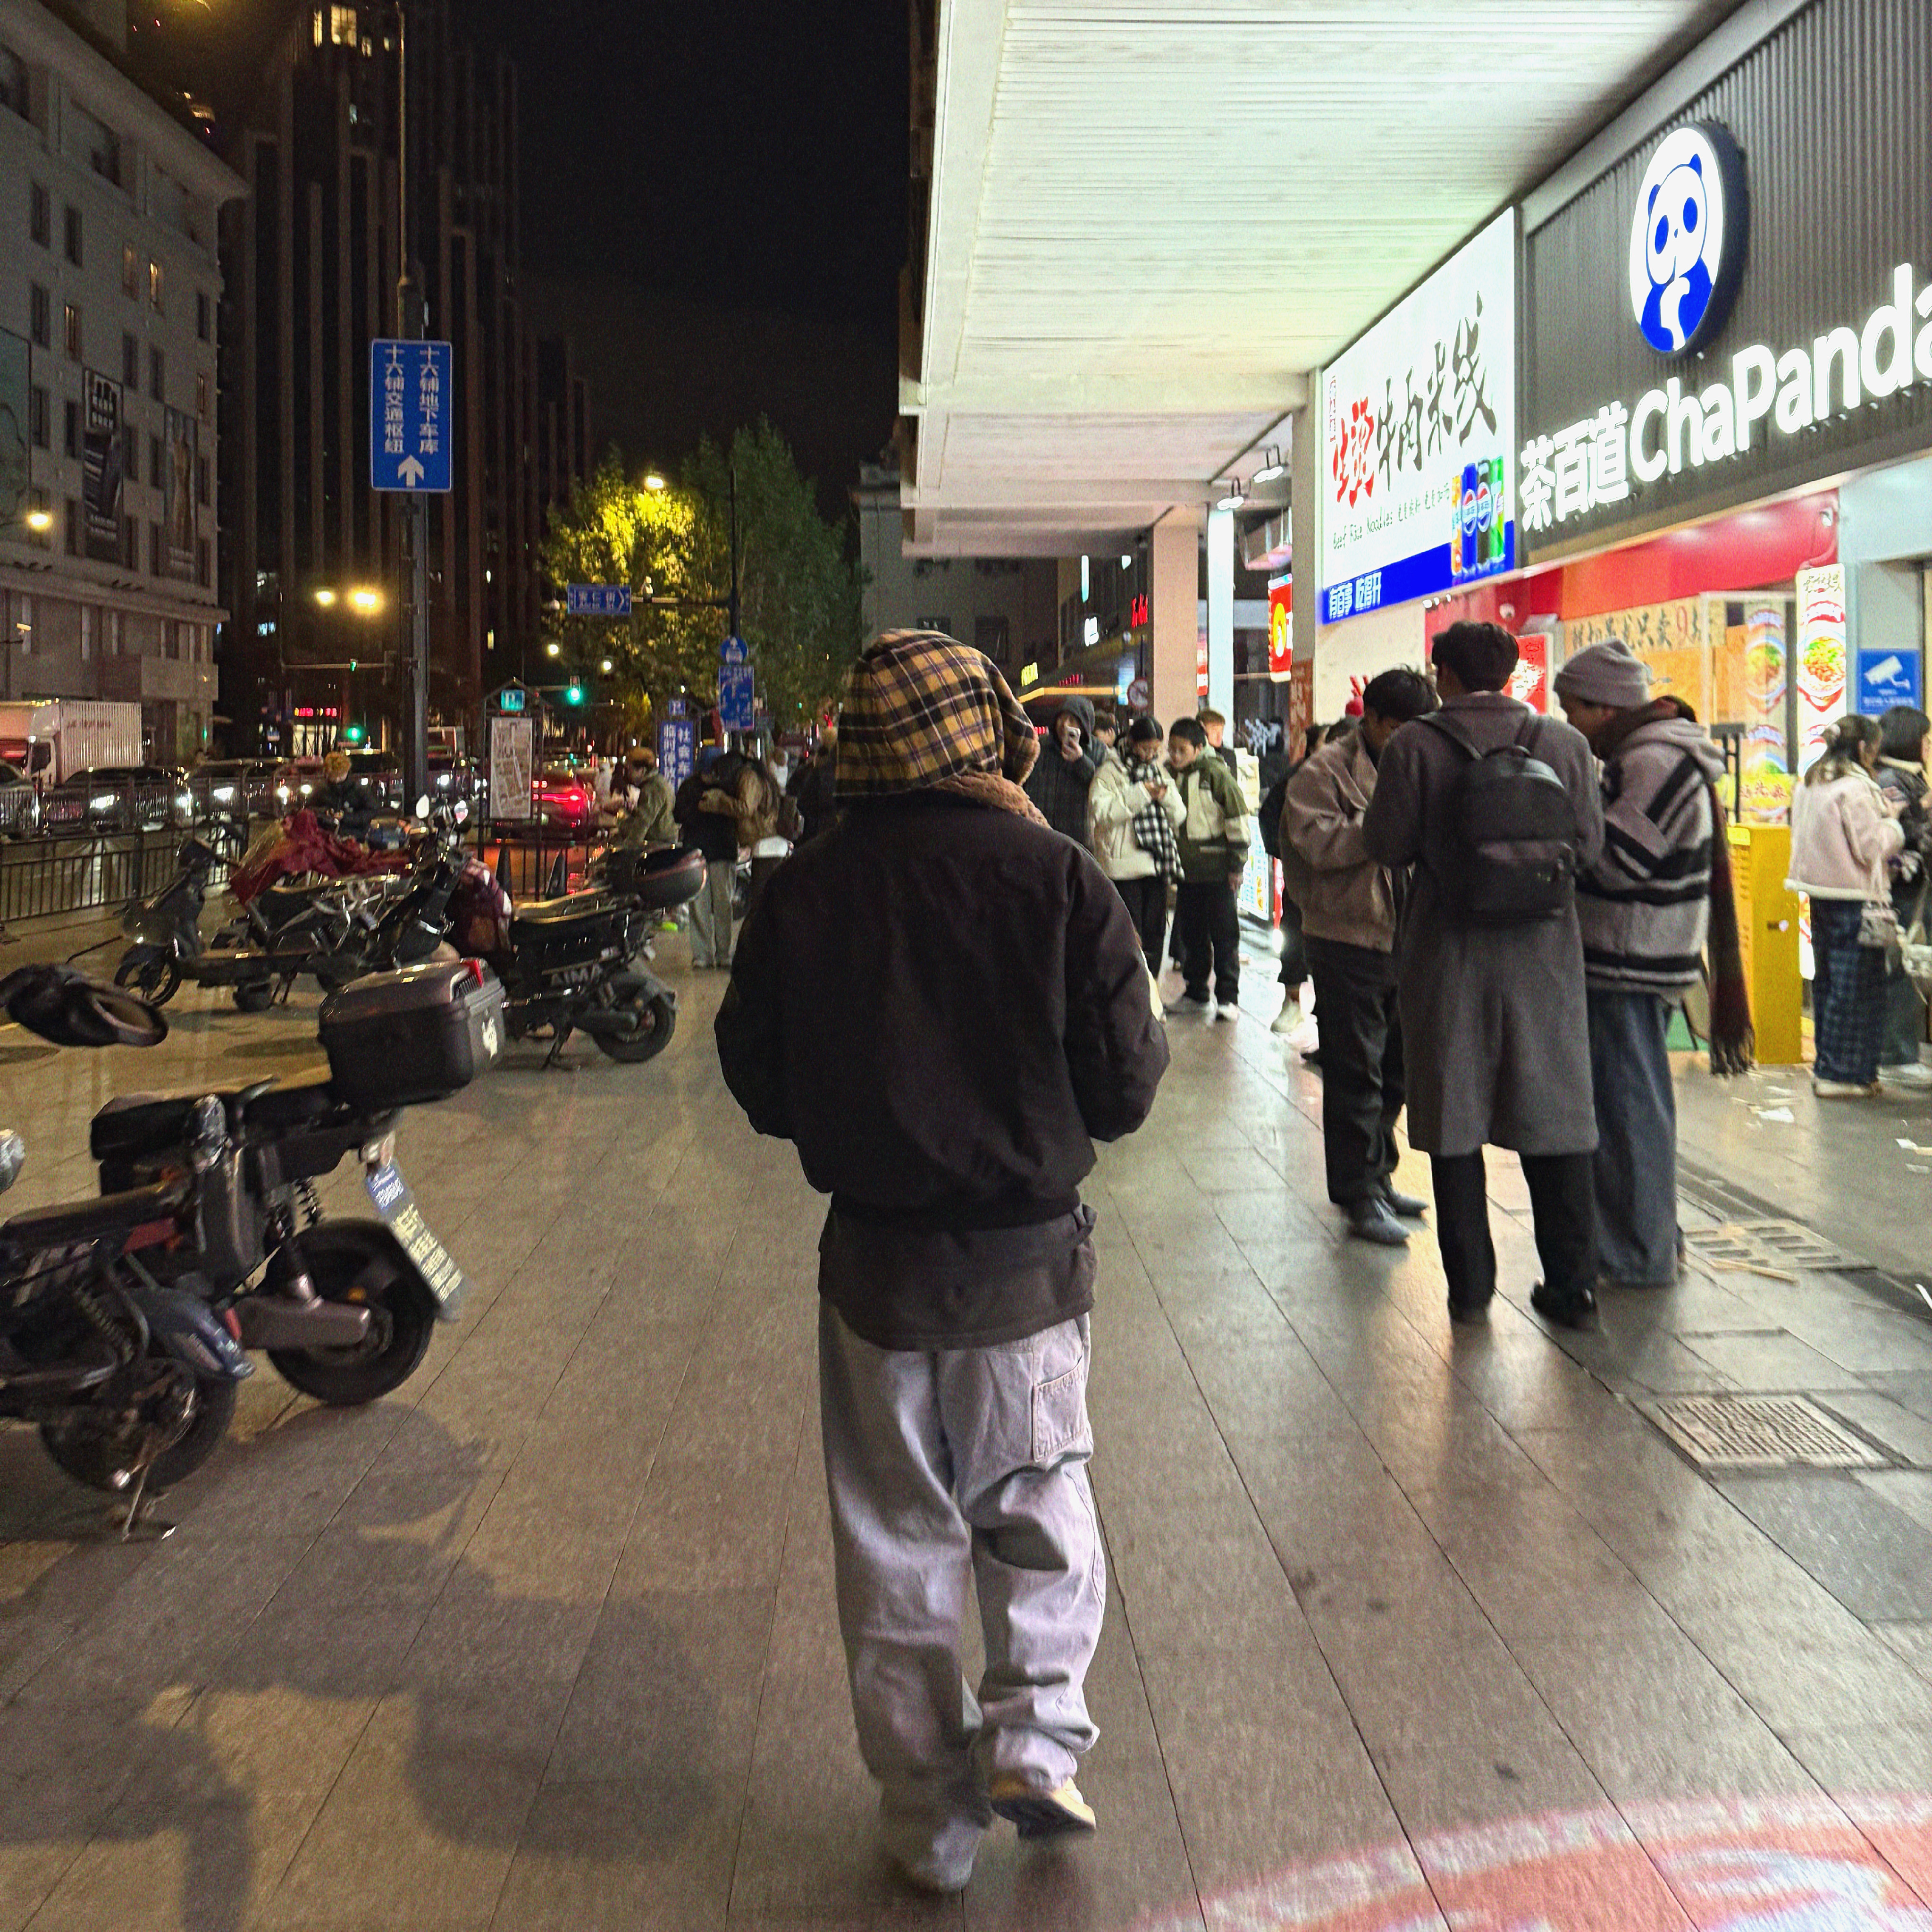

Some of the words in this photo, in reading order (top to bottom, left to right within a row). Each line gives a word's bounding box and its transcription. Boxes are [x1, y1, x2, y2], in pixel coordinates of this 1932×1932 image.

[1333, 290, 1497, 509] 生烫牛肉米线
[1520, 401, 1630, 532] 茶百道
[1329, 581, 1353, 621] 有百事
[1355, 571, 1382, 612] 吃得开
